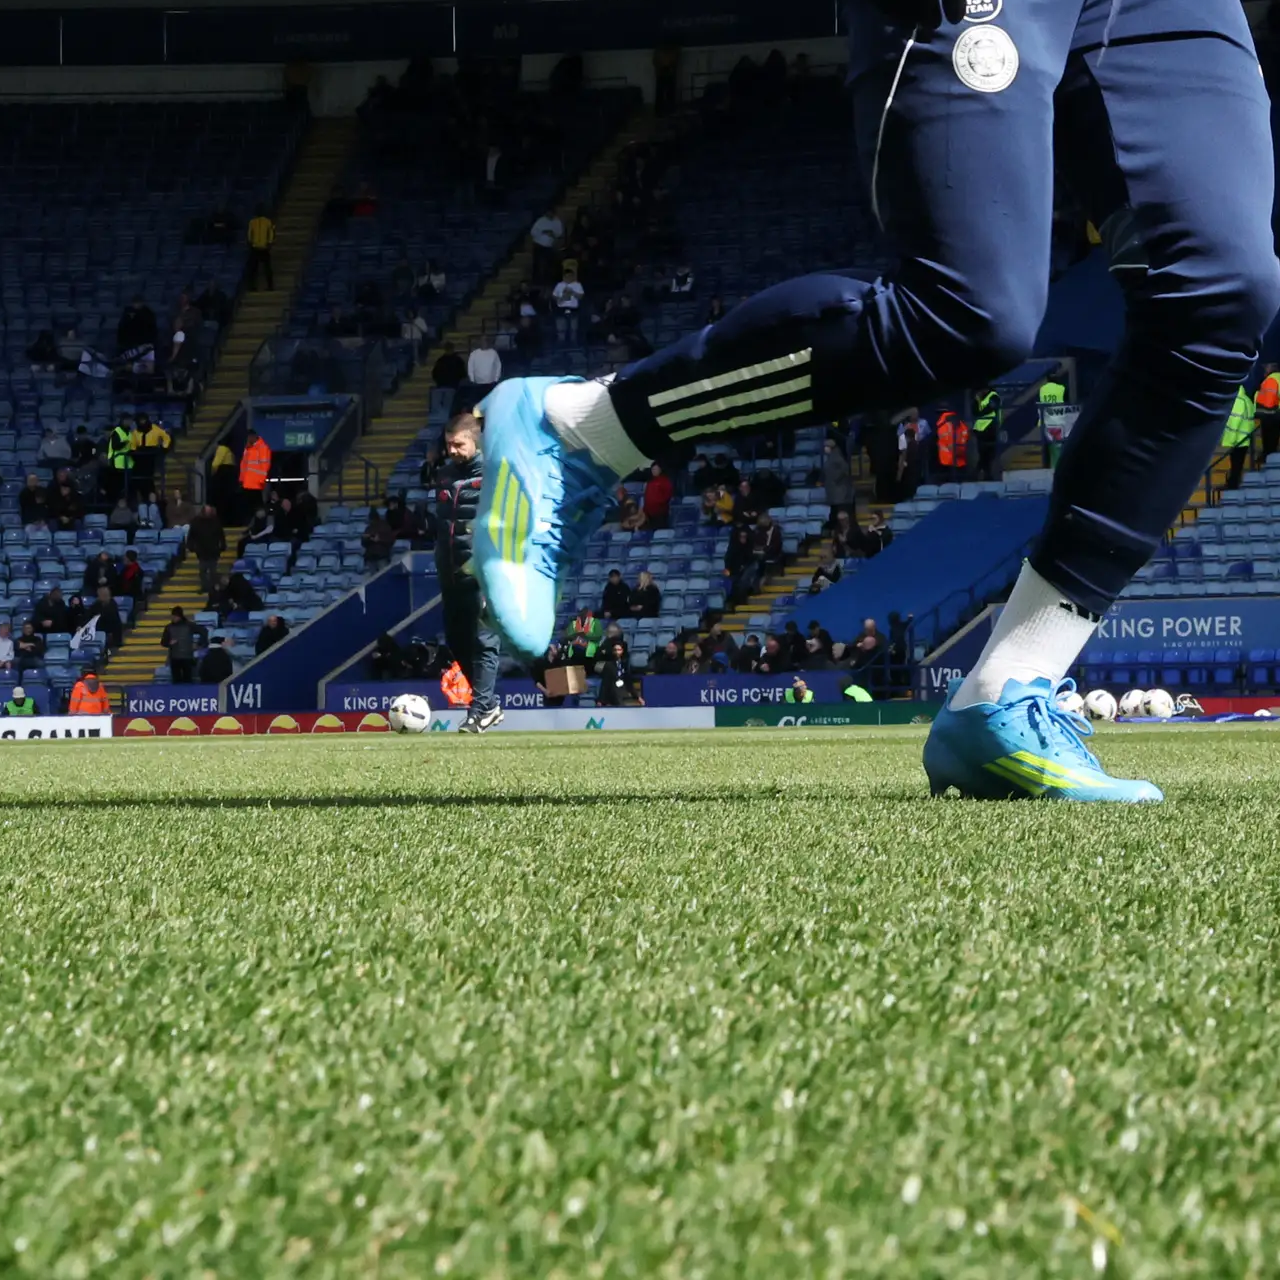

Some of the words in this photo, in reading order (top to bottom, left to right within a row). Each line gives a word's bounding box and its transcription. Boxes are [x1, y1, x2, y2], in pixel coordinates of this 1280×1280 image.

[1097, 618, 1155, 639] KING
[1162, 616, 1243, 638] POWER
[231, 683, 262, 708] V41
[505, 693, 544, 707] POWE
[700, 688, 738, 703] KING
[742, 687, 784, 703] POWE
[129, 698, 166, 713] KING
[169, 698, 218, 713] POWER
[343, 696, 378, 710] KING
